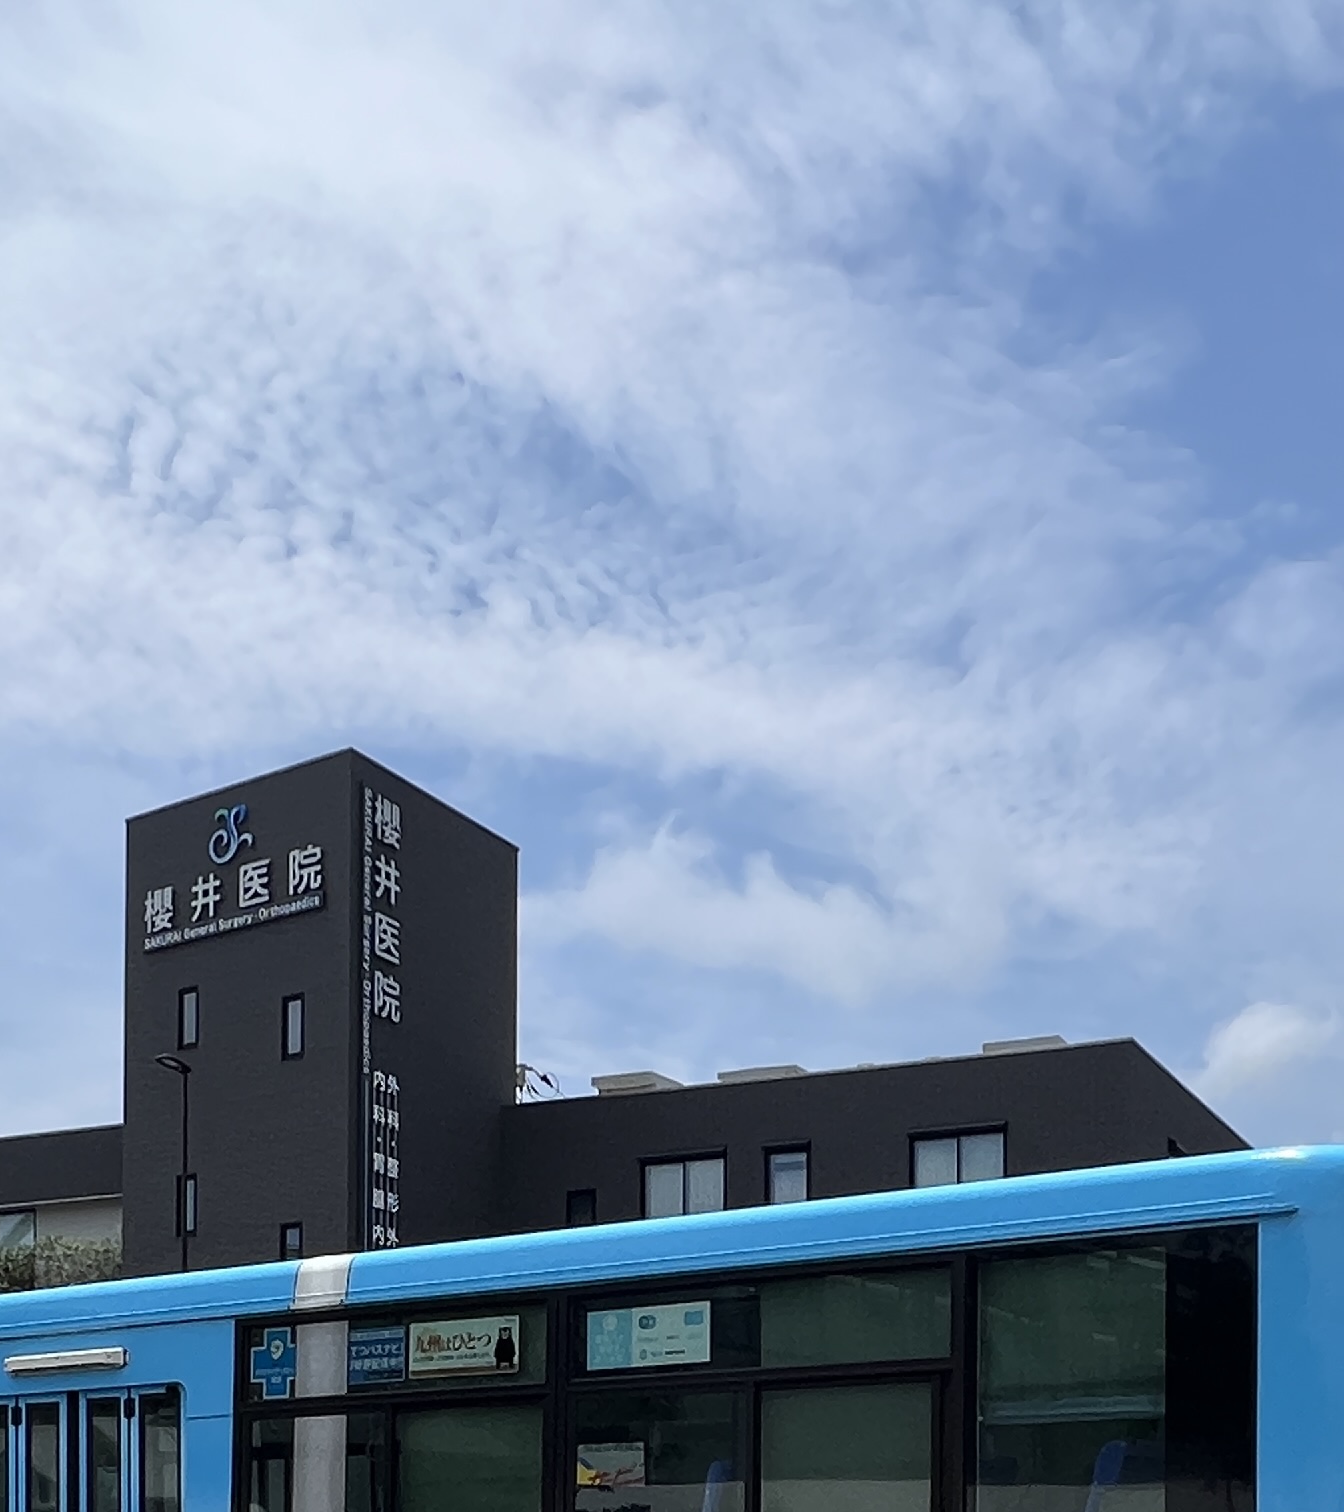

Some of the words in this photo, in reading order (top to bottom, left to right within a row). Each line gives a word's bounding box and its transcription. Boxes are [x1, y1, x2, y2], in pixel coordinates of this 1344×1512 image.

[363, 787, 373, 851] SAKURAI
[144, 845, 323, 933] 櫻井医院
[374, 794, 402, 1025] 櫻井医院
[144, 932, 182, 949] SAKURAI
[184, 922, 218, 940] General
[218, 913, 254, 931] Surgery
